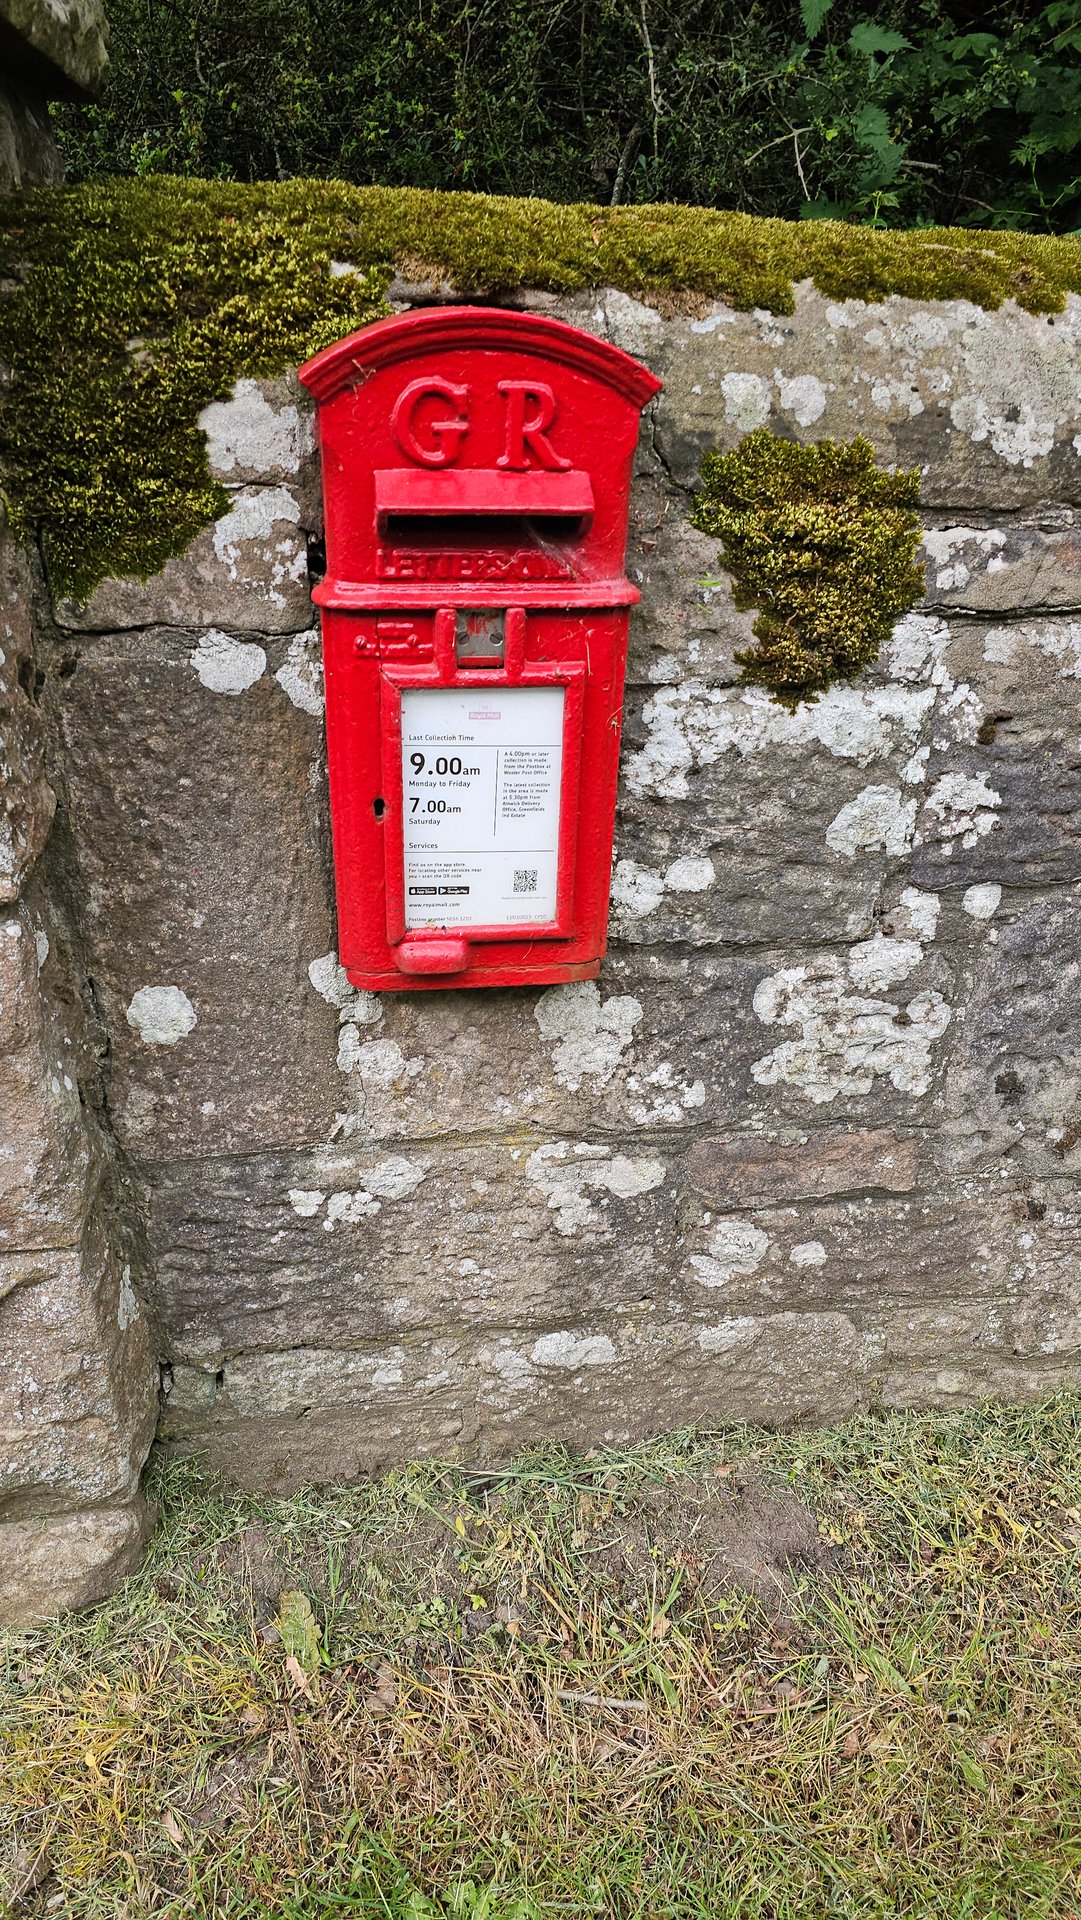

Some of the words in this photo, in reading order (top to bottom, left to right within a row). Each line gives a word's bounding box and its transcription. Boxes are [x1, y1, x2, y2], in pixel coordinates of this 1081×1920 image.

[410, 752, 480, 776] 9.00am
[408, 780, 436, 788] Monday
[448, 780, 472, 788] Friday
[409, 798, 462, 813] 7.00am
[408, 818, 440, 826] Saturday
